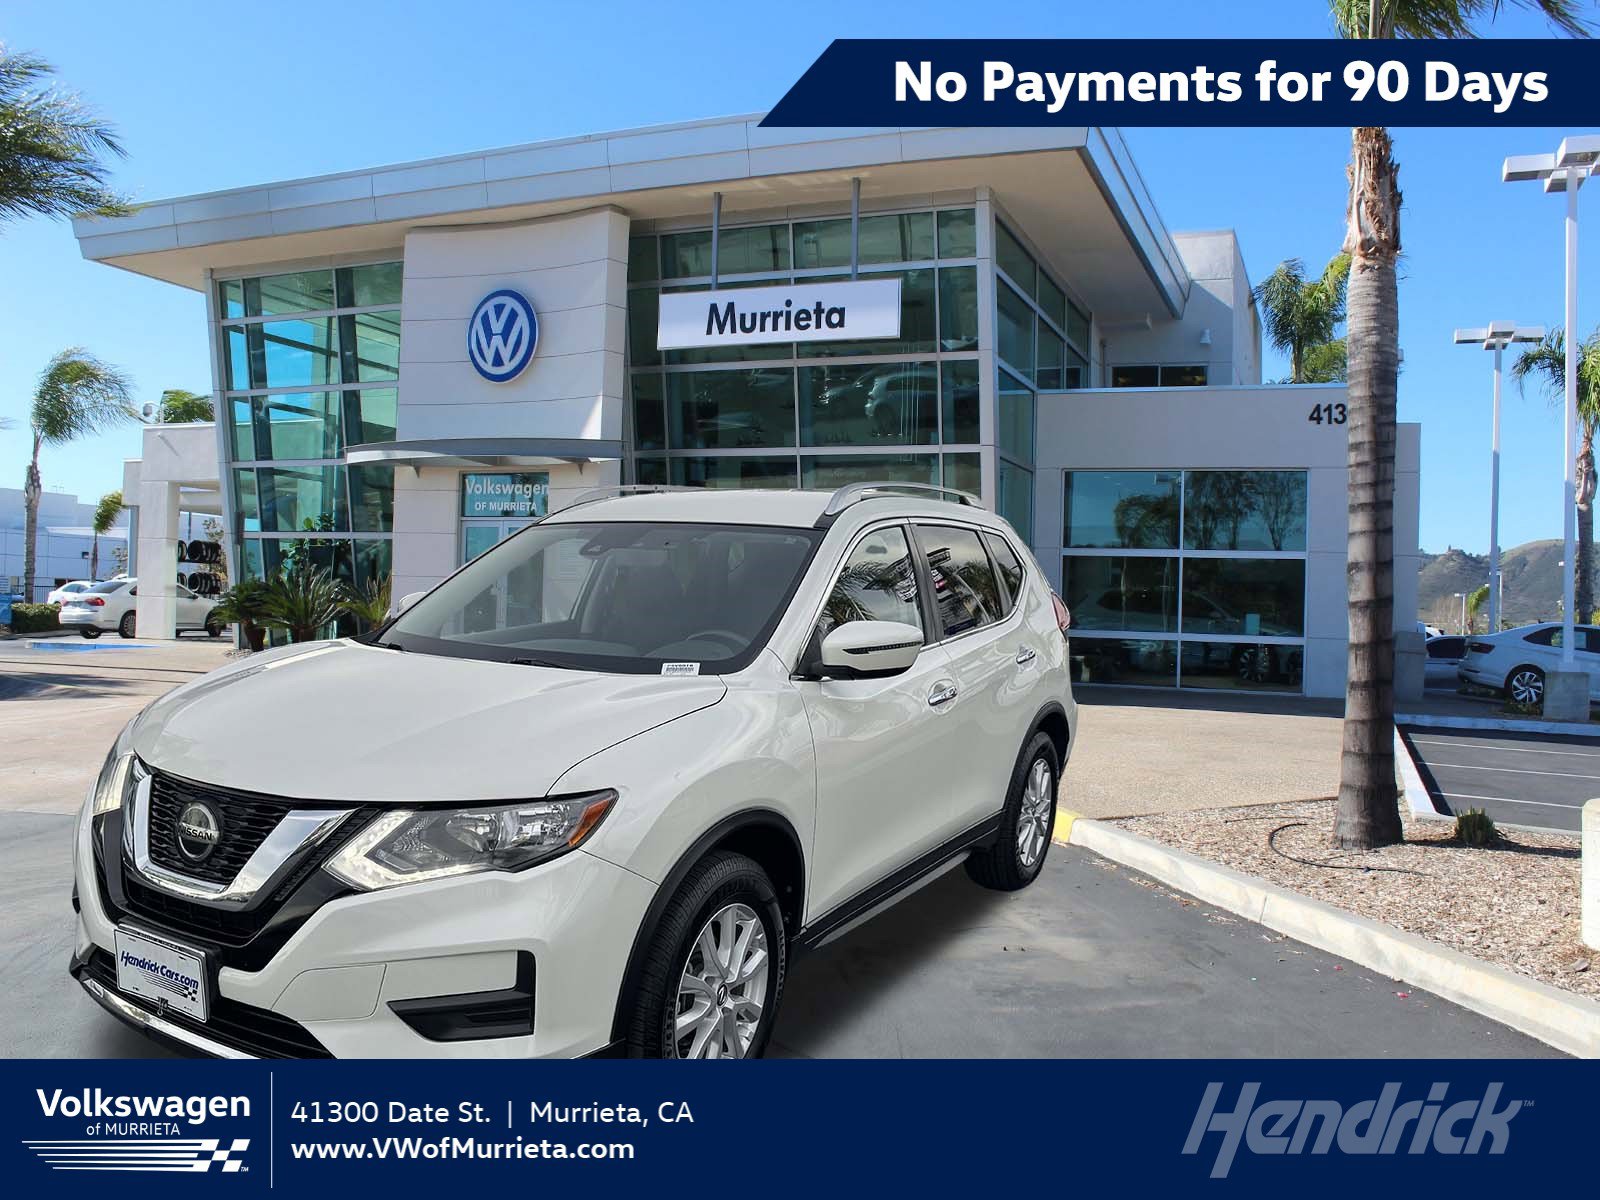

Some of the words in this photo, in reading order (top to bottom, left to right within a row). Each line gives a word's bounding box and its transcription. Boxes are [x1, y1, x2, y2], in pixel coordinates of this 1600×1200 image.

[706, 299, 846, 335] Murrieta
[465, 478, 549, 498] Volkswagen
[475, 502, 487, 511] OF
[489, 501, 537, 512] MURRIETA
